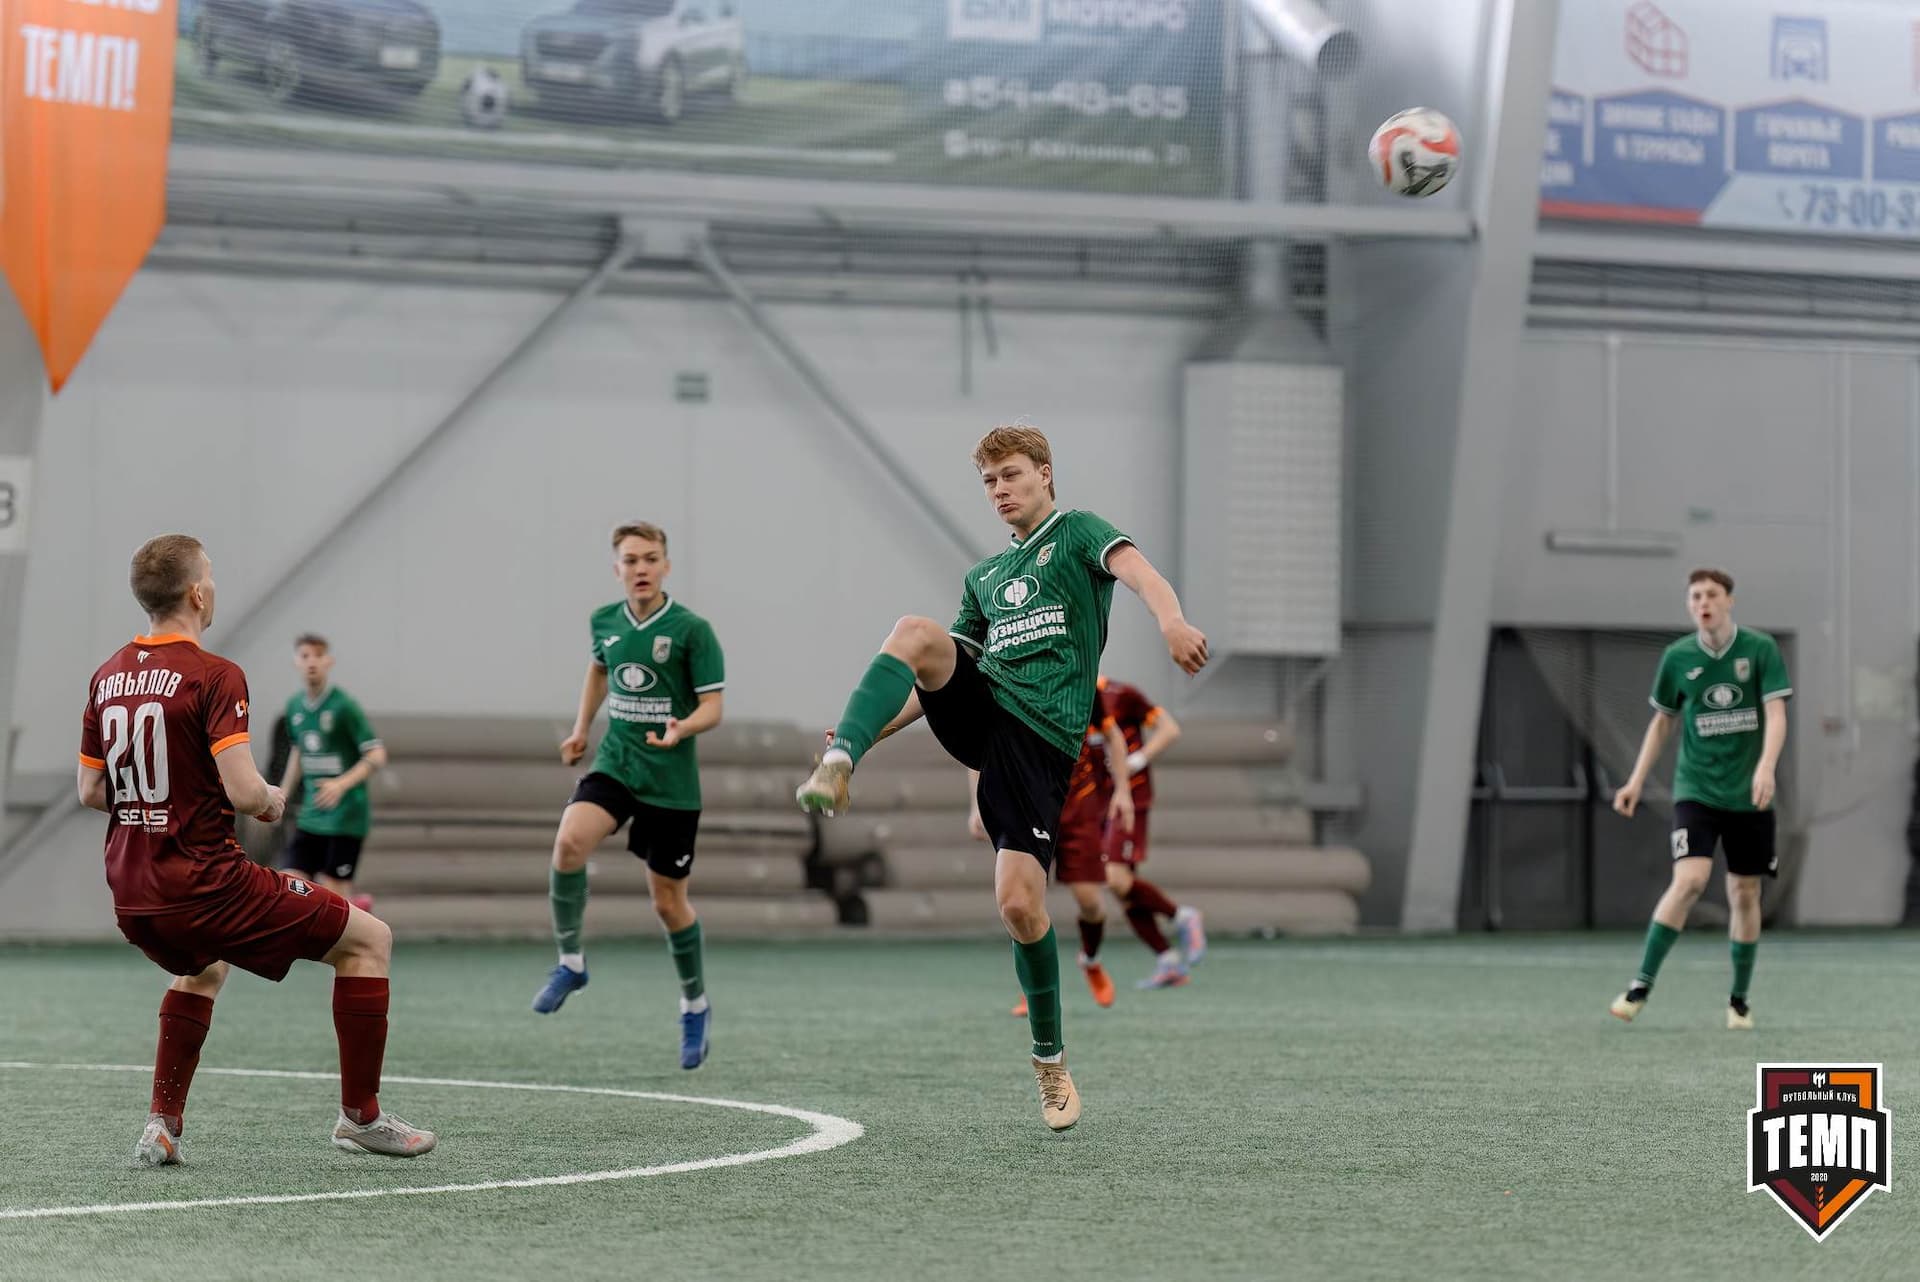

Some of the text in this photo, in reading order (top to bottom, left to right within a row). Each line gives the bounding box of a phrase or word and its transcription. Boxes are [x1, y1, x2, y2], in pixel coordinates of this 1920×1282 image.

[21, 25, 139, 110] ТЕМП!
[97, 669, 182, 704] ЗАВЬЯЛОВ
[102, 702, 169, 804] 20
